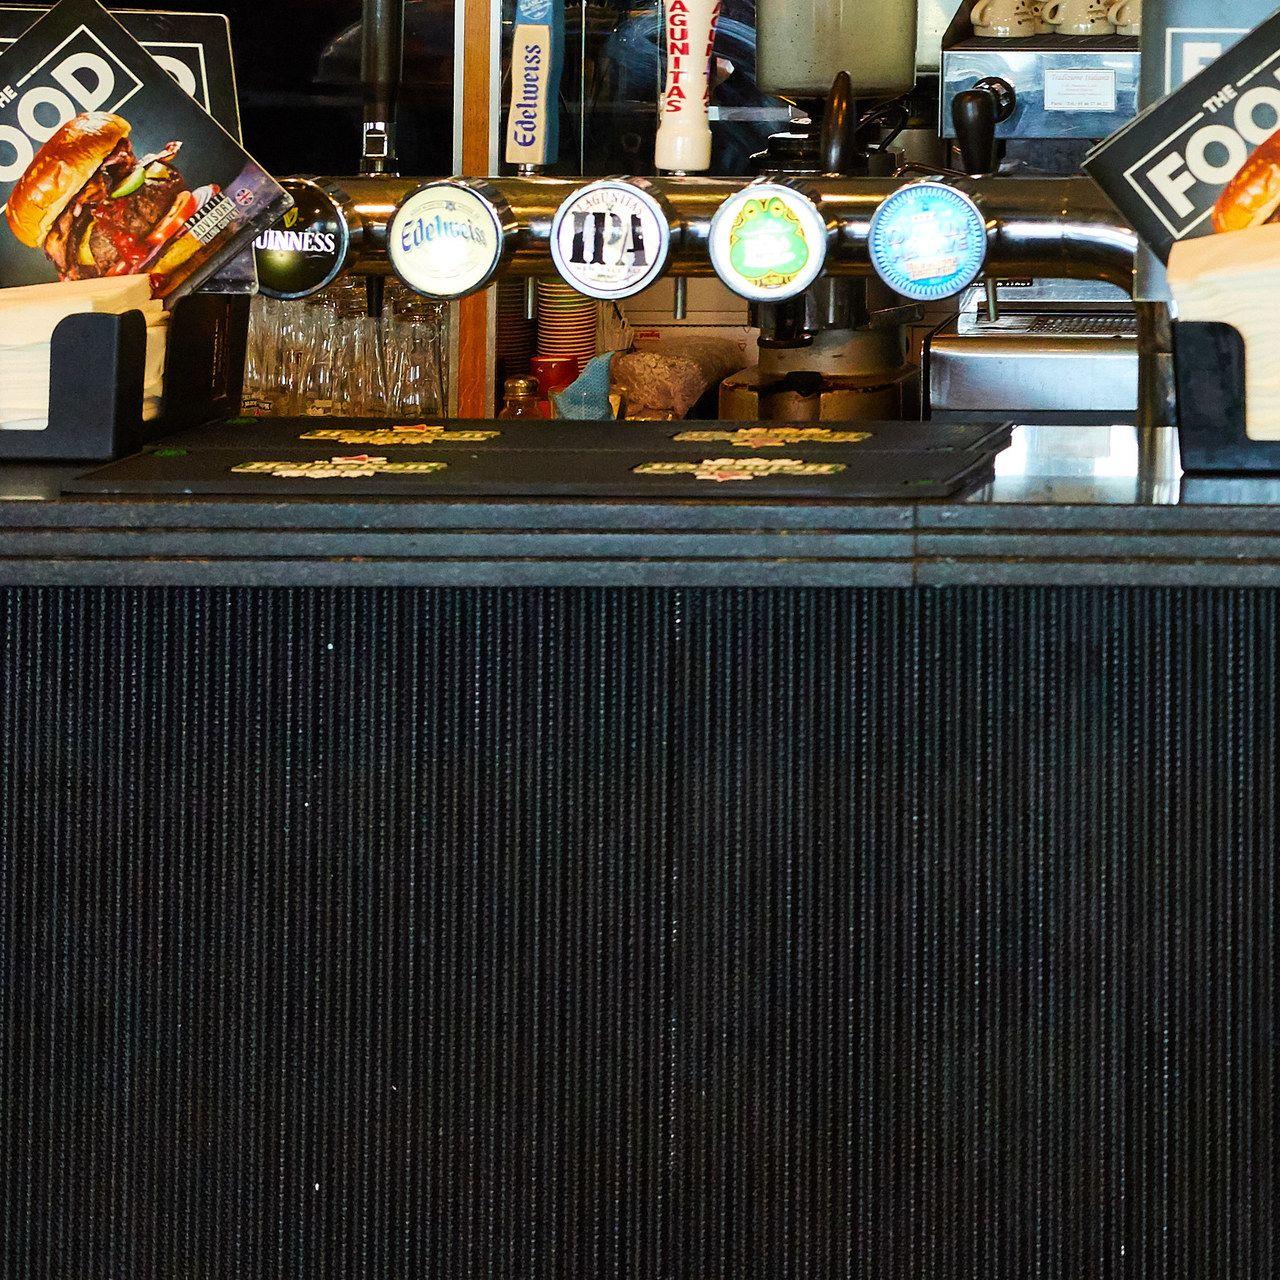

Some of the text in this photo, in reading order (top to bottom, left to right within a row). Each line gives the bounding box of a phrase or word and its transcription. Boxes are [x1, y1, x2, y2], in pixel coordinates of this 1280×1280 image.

[513, 43, 542, 148] Edelweiss
[1203, 83, 1239, 116] THE
[191, 199, 234, 238] ADVISORY
[401, 214, 489, 253] Edelweiss
[568, 211, 649, 267] IPA
